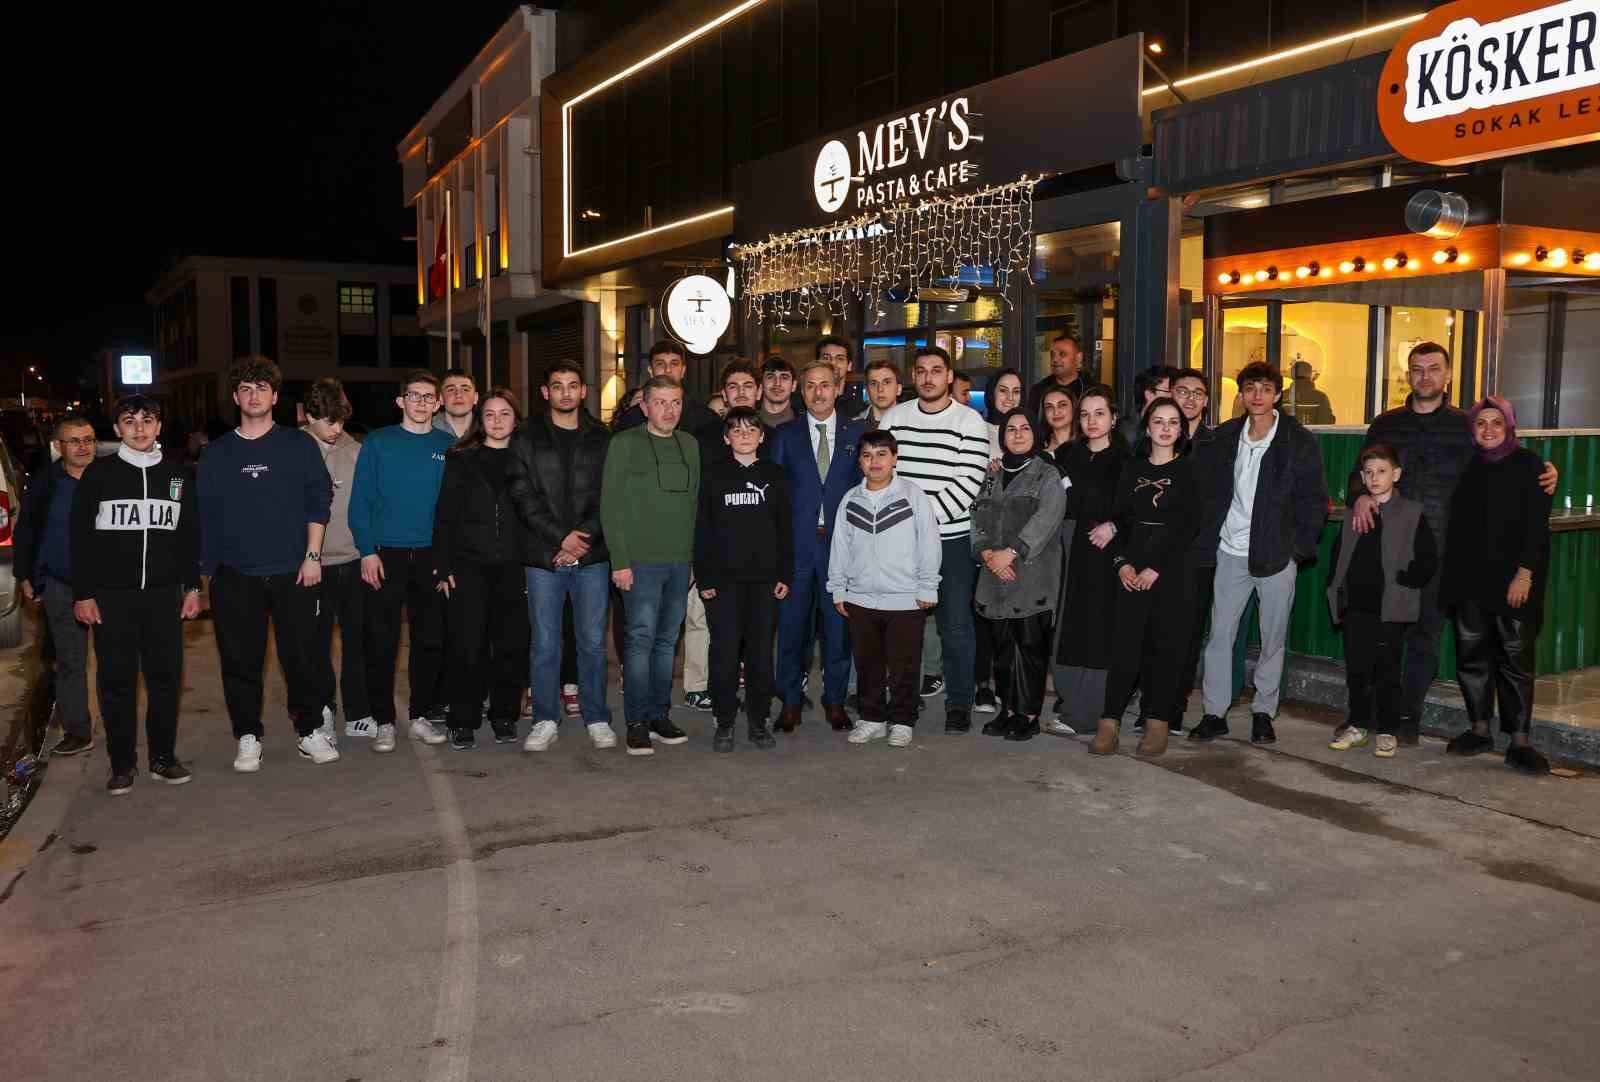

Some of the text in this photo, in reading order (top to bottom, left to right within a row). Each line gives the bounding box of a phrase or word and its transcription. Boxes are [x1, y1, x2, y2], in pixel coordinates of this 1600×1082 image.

[857, 97, 969, 176] MEV'S
[1456, 97, 1600, 137] SOKAK LE
[925, 160, 969, 191] CAFE
